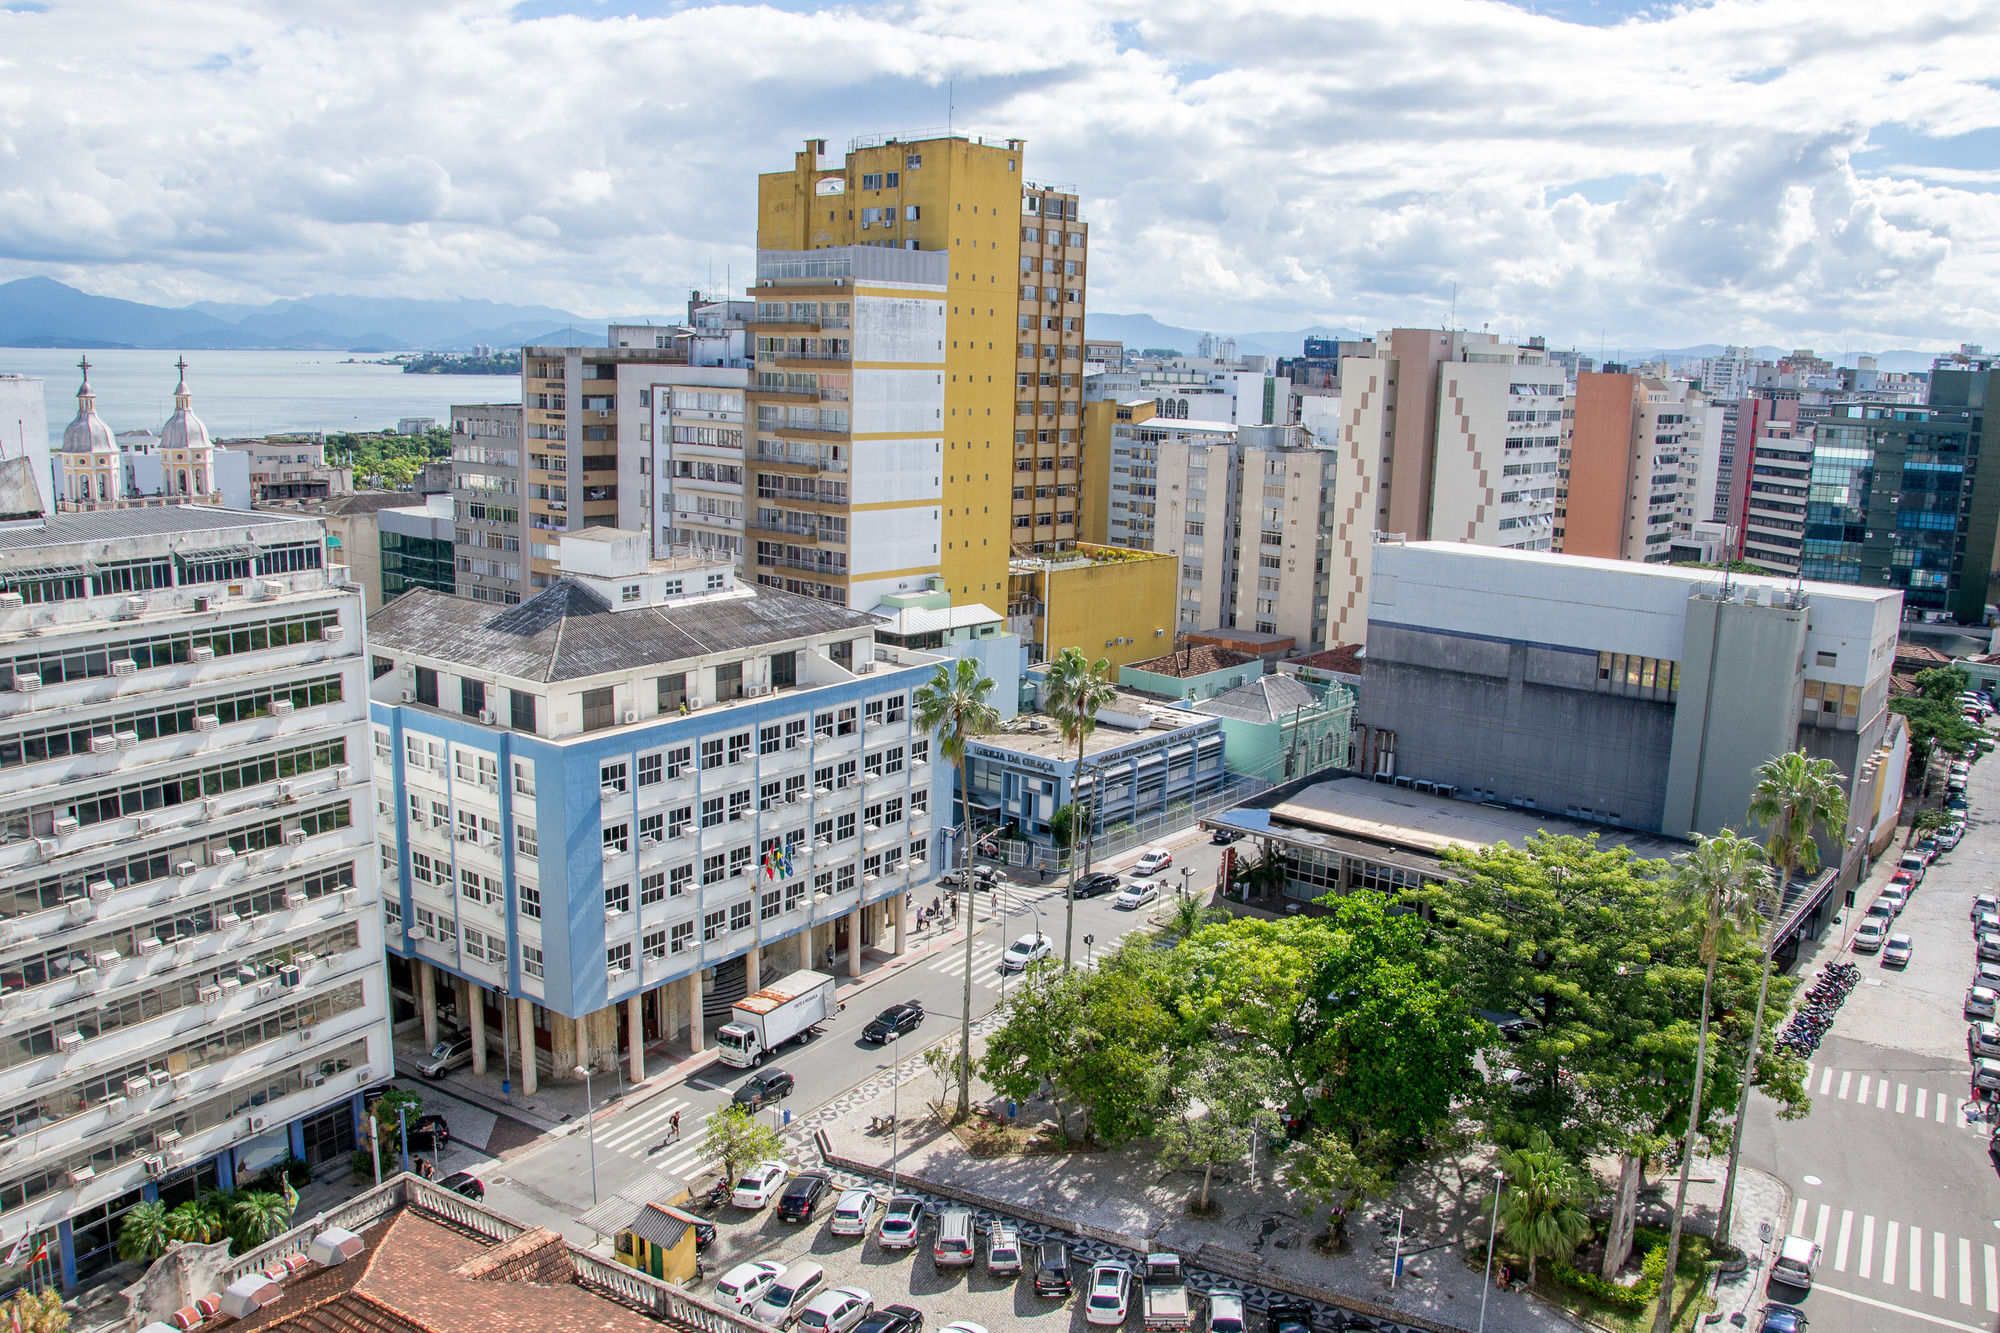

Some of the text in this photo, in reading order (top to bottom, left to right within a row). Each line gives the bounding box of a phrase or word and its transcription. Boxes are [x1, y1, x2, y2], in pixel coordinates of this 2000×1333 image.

[974, 746, 1056, 773] IGREJA DA GRAÇA
